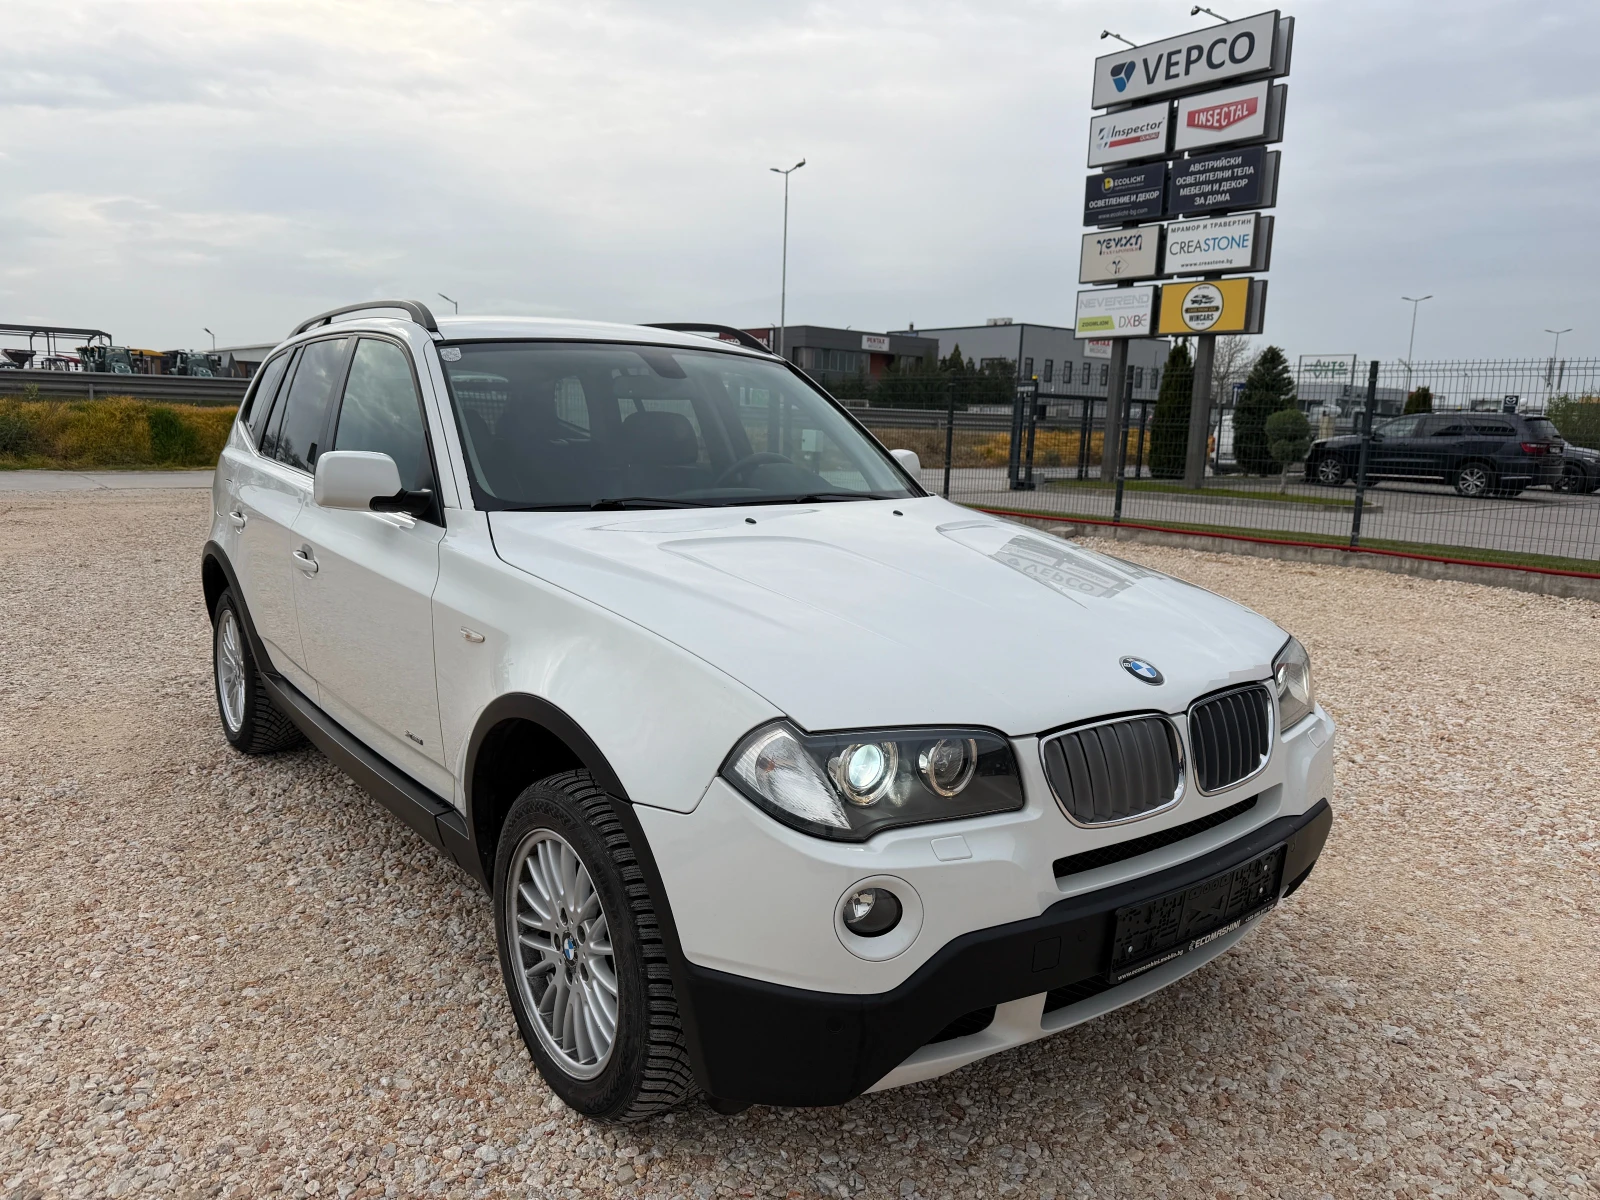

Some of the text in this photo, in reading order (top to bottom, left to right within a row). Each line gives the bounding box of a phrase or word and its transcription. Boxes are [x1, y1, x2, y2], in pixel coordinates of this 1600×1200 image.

[1142, 31, 1256, 85] VEPCO
[1194, 103, 1249, 126] INSECTAL
[1111, 120, 1163, 138] Inspector
[1189, 156, 1242, 172] АВСТРИЙСКИ
[1176, 165, 1255, 185] ОСВЕТИТЕЛНИ ТЕЛА
[1179, 178, 1248, 196] МЕБЕЛИ И ДЕКОР
[1089, 195, 1130, 208] ОСВЕТЛЕНИЕ
[1136, 190, 1160, 202] ДЕКОР
[1194, 192, 1231, 205] ЗА ДОМА
[1171, 224, 1201, 233] МРАМОР
[1210, 218, 1252, 228] ТРАВЕРТИН
[1169, 234, 1250, 255] CREASTONE
[1181, 258, 1233, 268] www.creastone.bg
[1080, 294, 1150, 309] NEVEREND
[1082, 320, 1109, 328] ZOOMLION
[1189, 313, 1214, 322] WINCARS
[1195, 919, 1241, 948] ECOMASHINI
